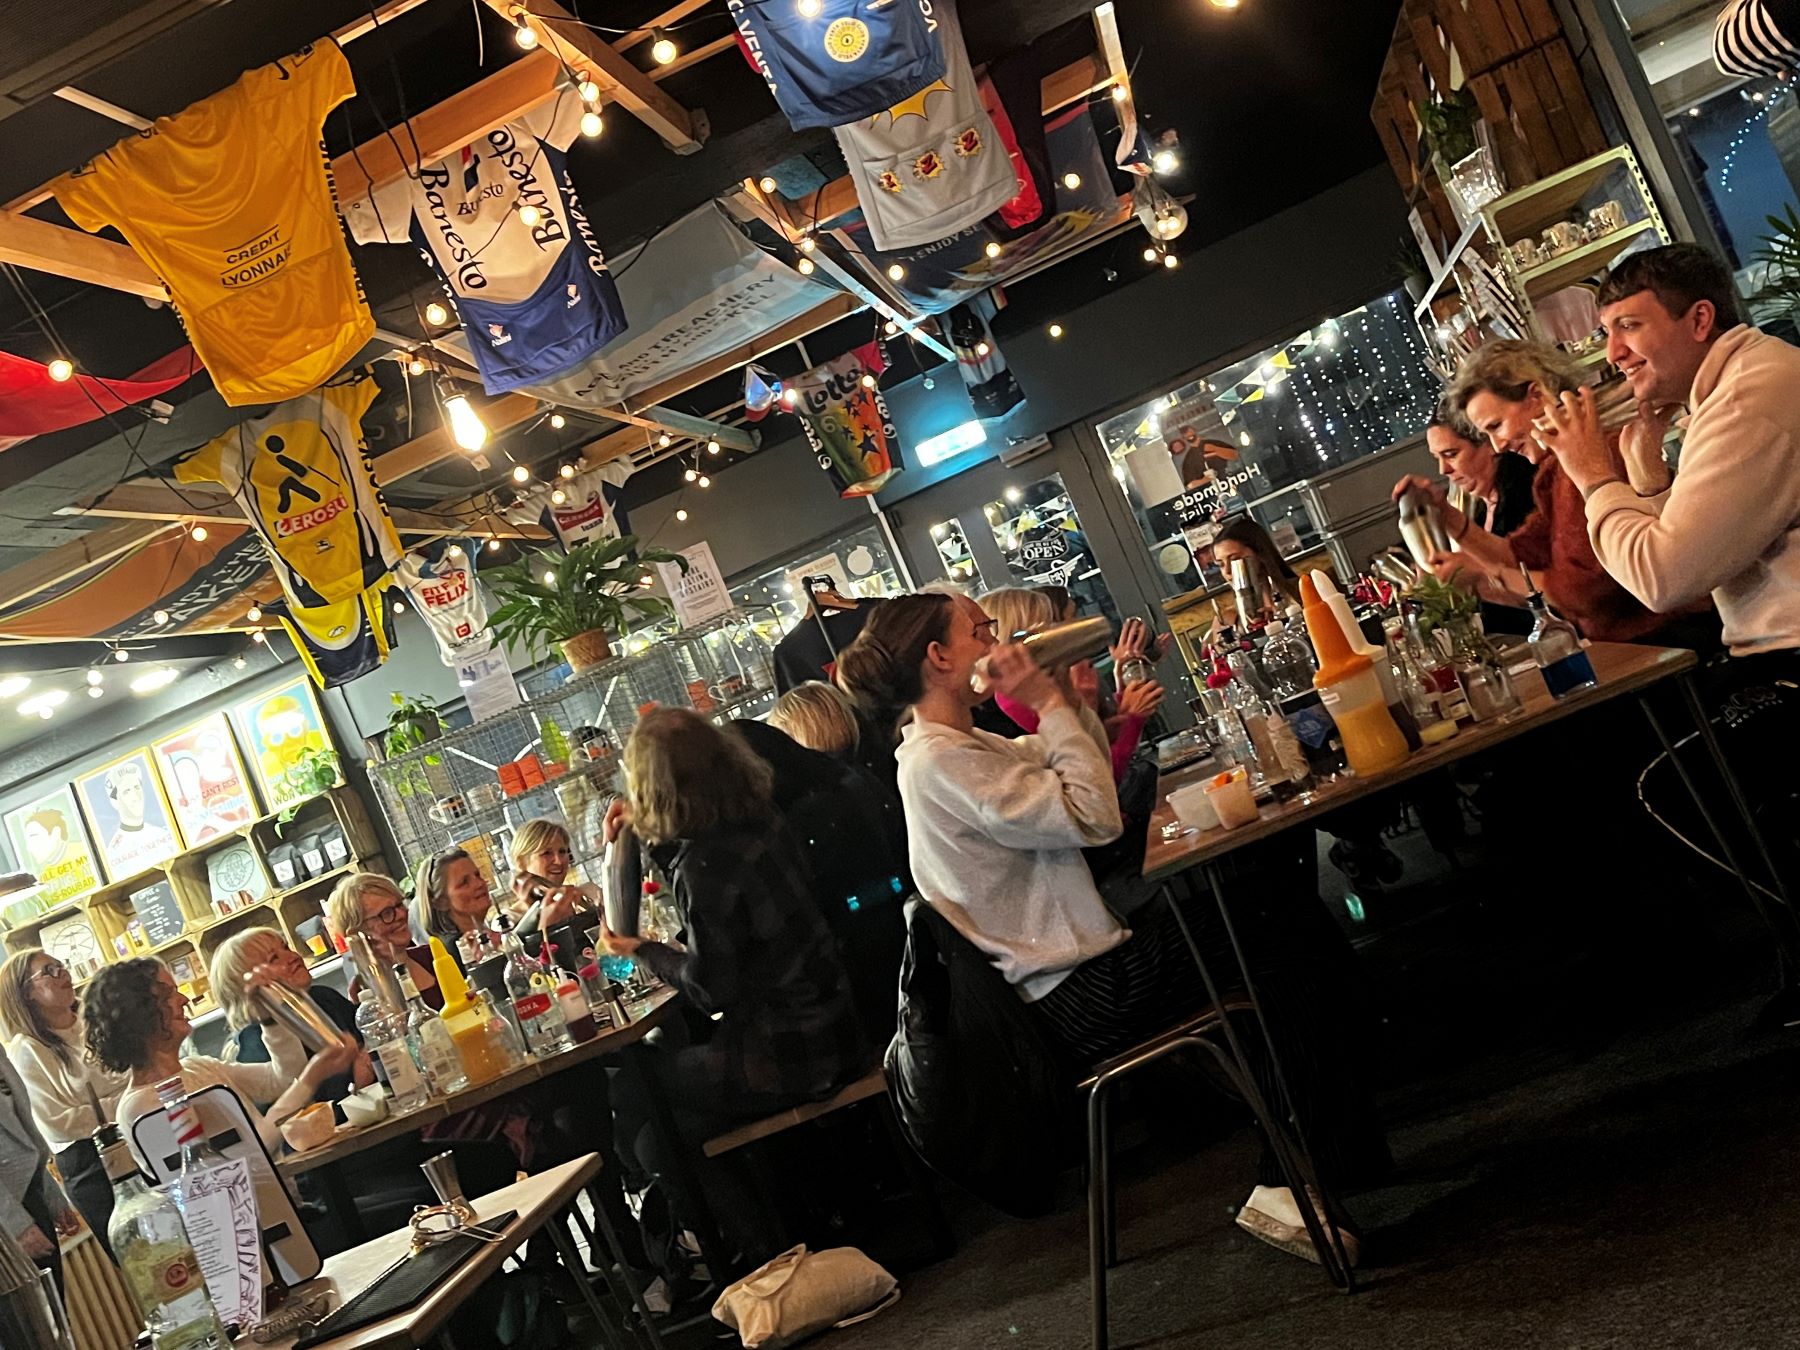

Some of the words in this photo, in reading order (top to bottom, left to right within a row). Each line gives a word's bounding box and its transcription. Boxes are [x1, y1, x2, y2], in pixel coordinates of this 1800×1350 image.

[419, 161, 489, 292] Banesto
[226, 229, 280, 264] CREDIT
[916, 230, 960, 260] ENJOY
[645, 273, 777, 352] TREACHERY
[712, 290, 777, 328] SKILL
[802, 367, 864, 415] Lotto
[1023, 540, 1065, 561] OPEN
[163, 578, 212, 613] NOT
[424, 578, 469, 609] FELIX
[56, 860, 74, 876] GET
[75, 854, 90, 867] MY
